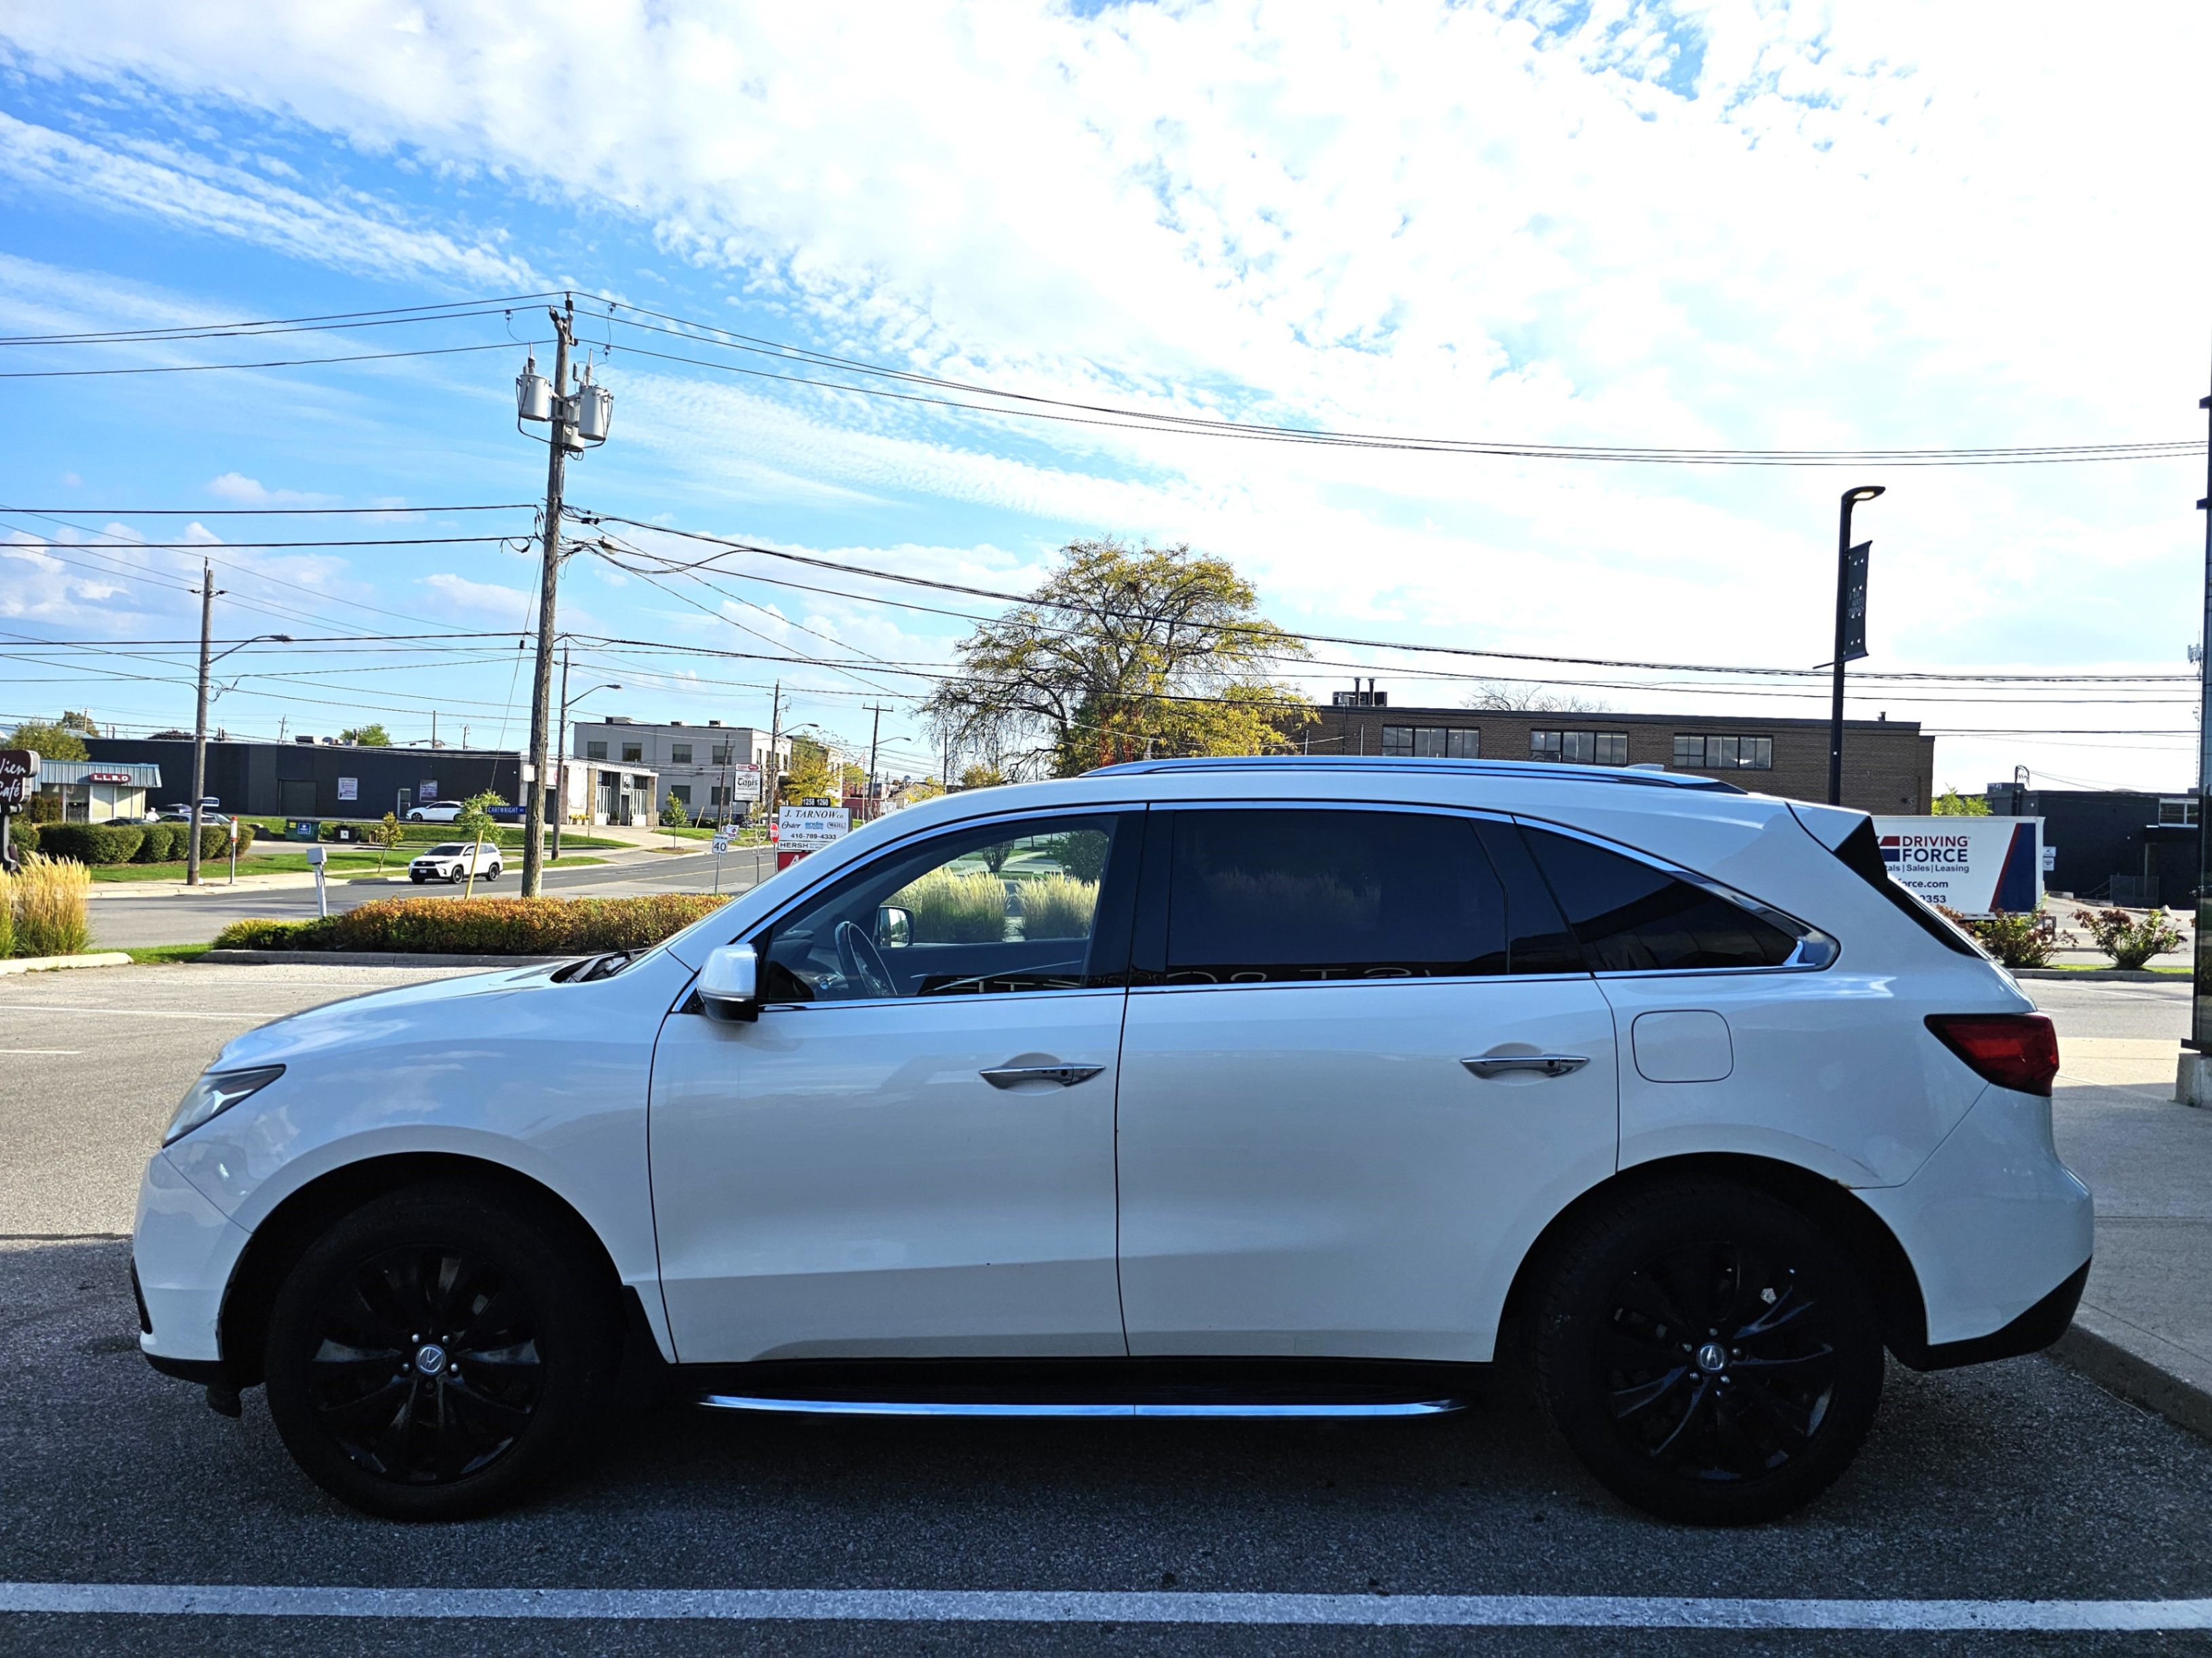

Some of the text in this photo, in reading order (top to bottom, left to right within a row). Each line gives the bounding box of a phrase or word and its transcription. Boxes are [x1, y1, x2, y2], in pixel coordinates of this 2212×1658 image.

[737, 777, 758, 788] Tapis
[795, 810, 837, 819] TARNOW
[782, 821, 801, 829] Oster
[1902, 836, 1968, 847] DRIVING
[714, 842, 727, 851] 40
[1902, 848, 1968, 863] FORCE
[1935, 864, 1970, 873] Leasing
